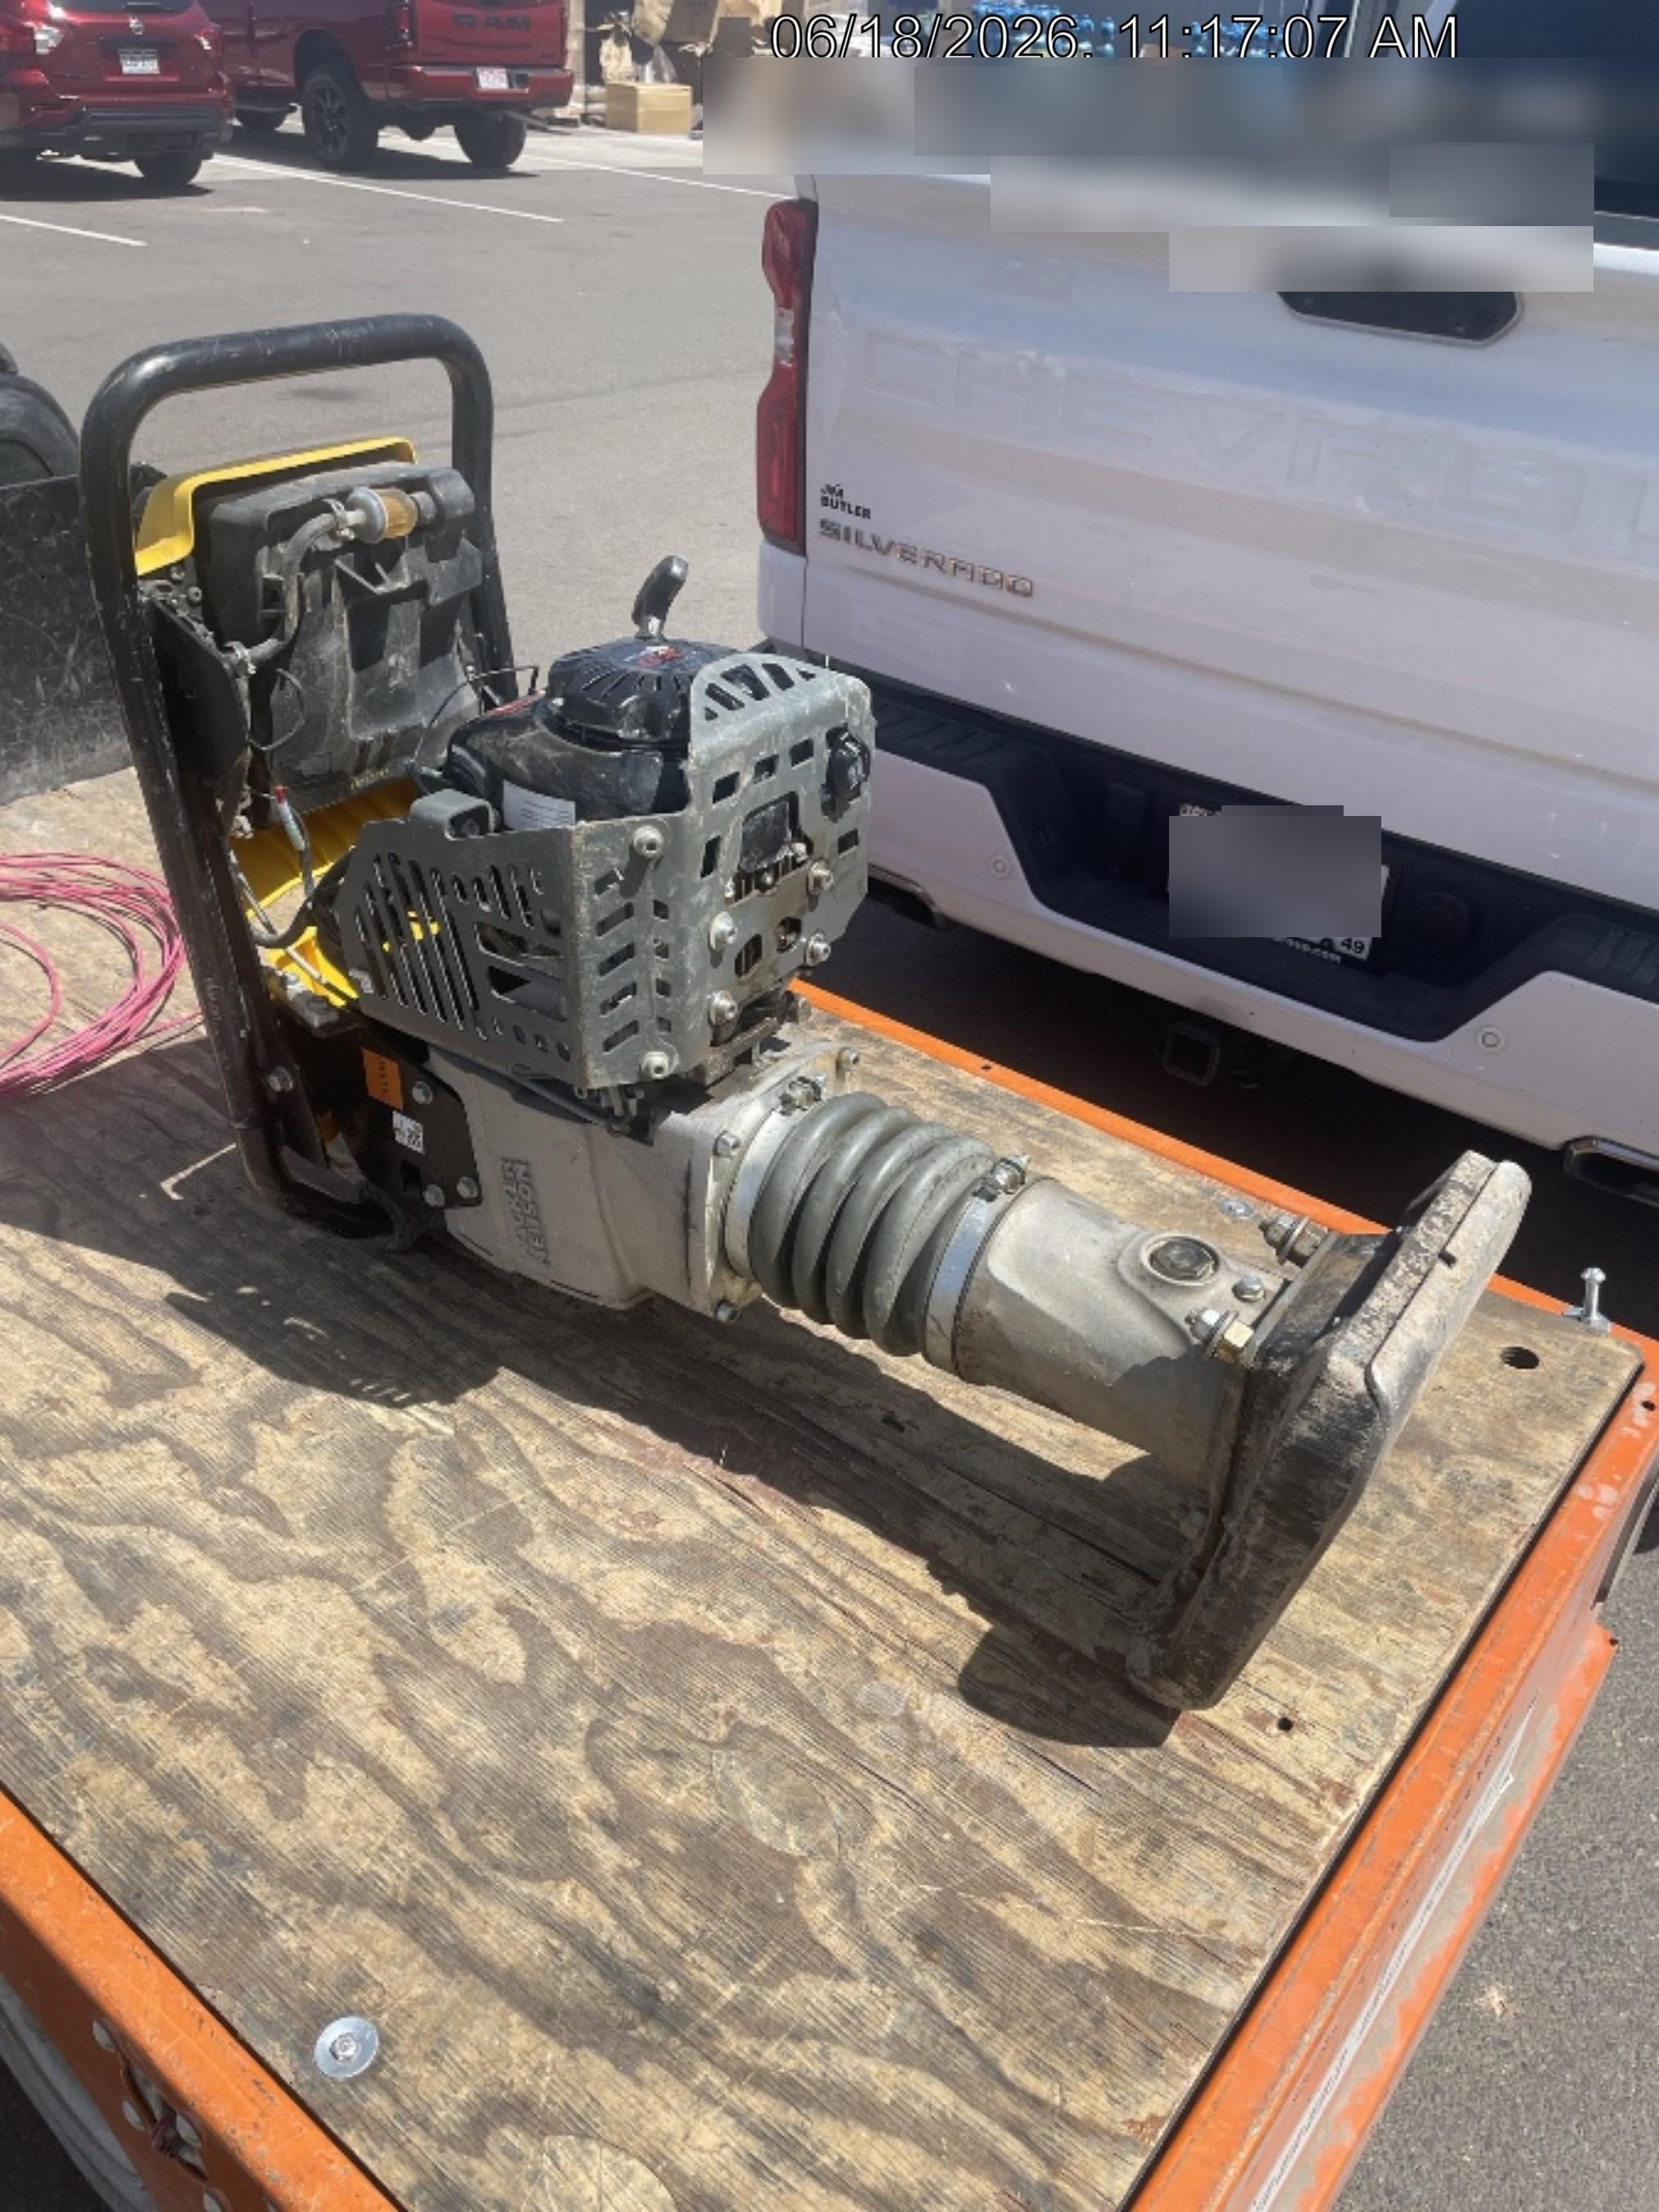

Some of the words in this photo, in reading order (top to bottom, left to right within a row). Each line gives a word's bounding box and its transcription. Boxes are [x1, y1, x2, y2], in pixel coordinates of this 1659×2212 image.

[452, 13, 531, 30] RAM
[820, 496, 872, 519] BUTLER
[819, 518, 1034, 597] SILVERADO
